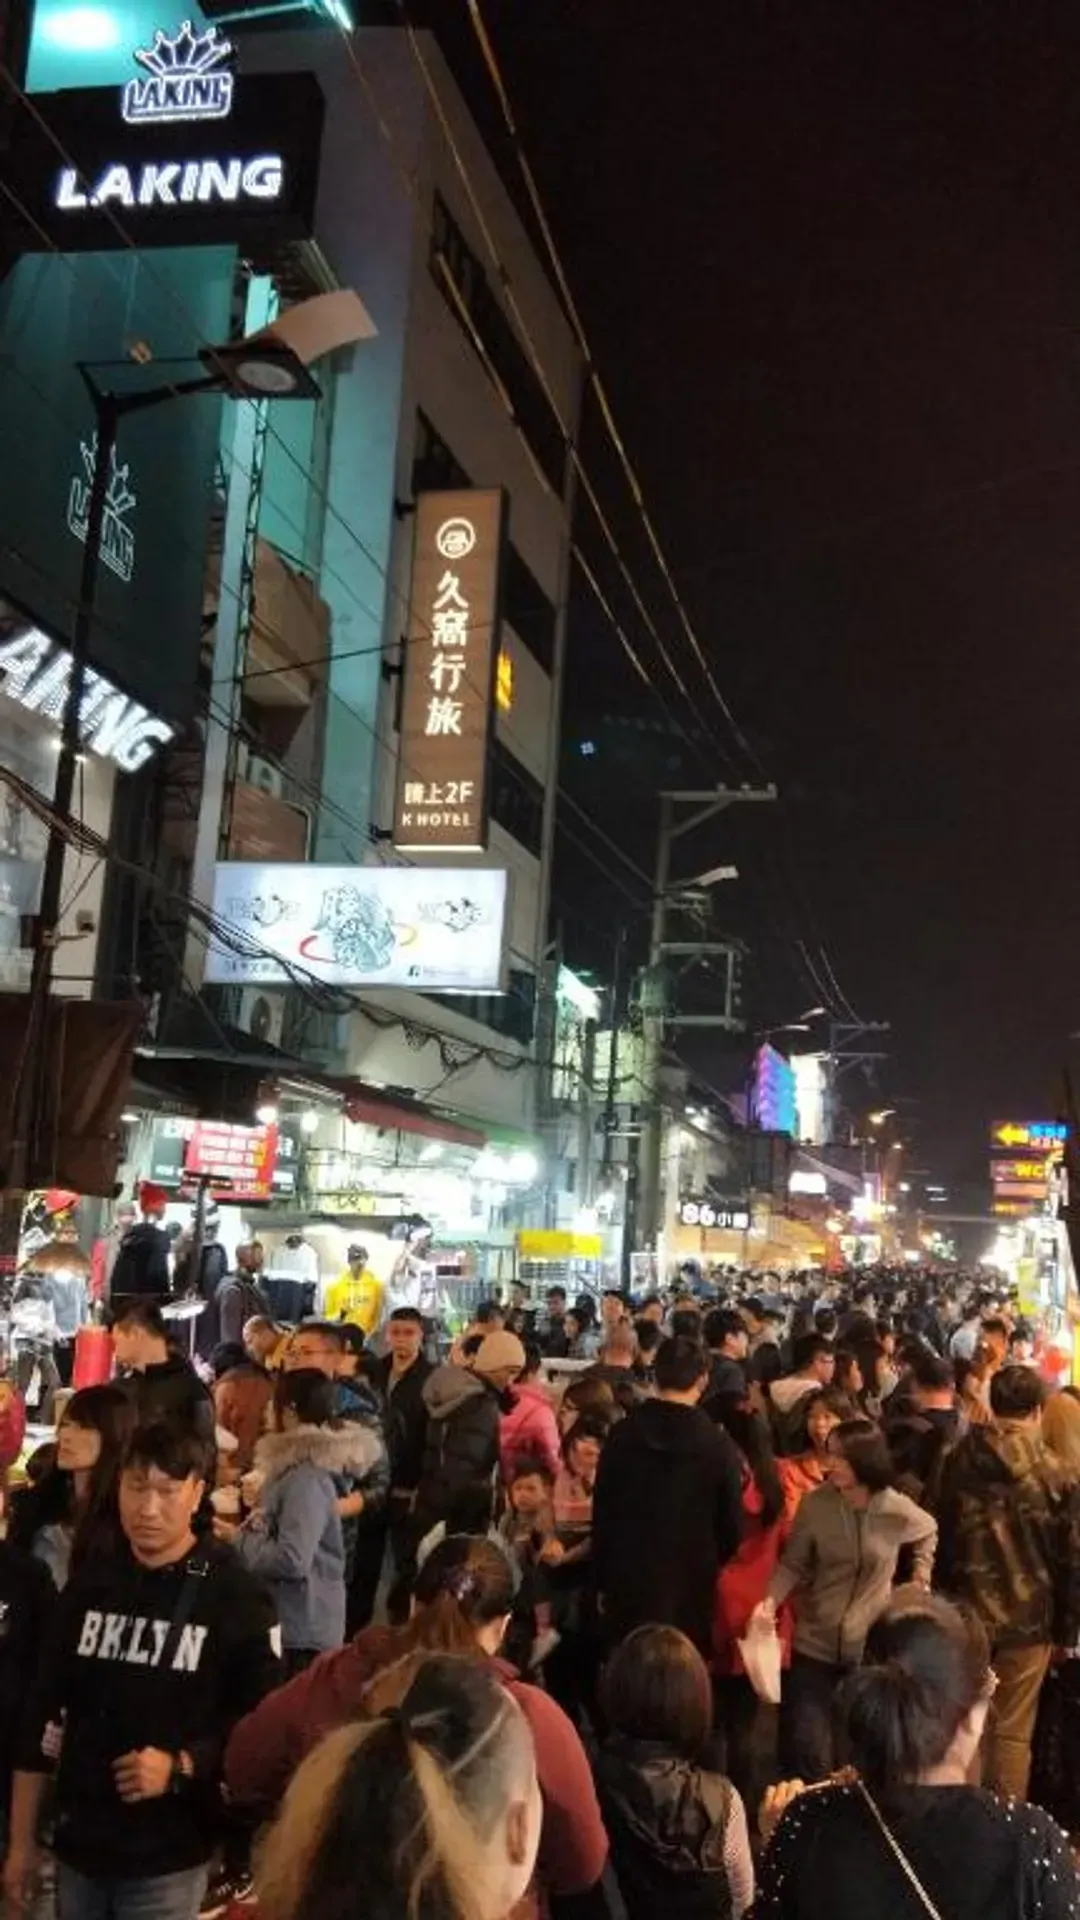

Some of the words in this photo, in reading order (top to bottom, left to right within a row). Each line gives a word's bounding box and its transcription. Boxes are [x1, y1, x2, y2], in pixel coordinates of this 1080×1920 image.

[124, 75, 232, 120] LAKING
[56, 156, 282, 209] LAKING
[425, 570, 469, 736] 久窩行旅
[402, 812, 412, 826] K
[417, 812, 470, 827] HOTEL
